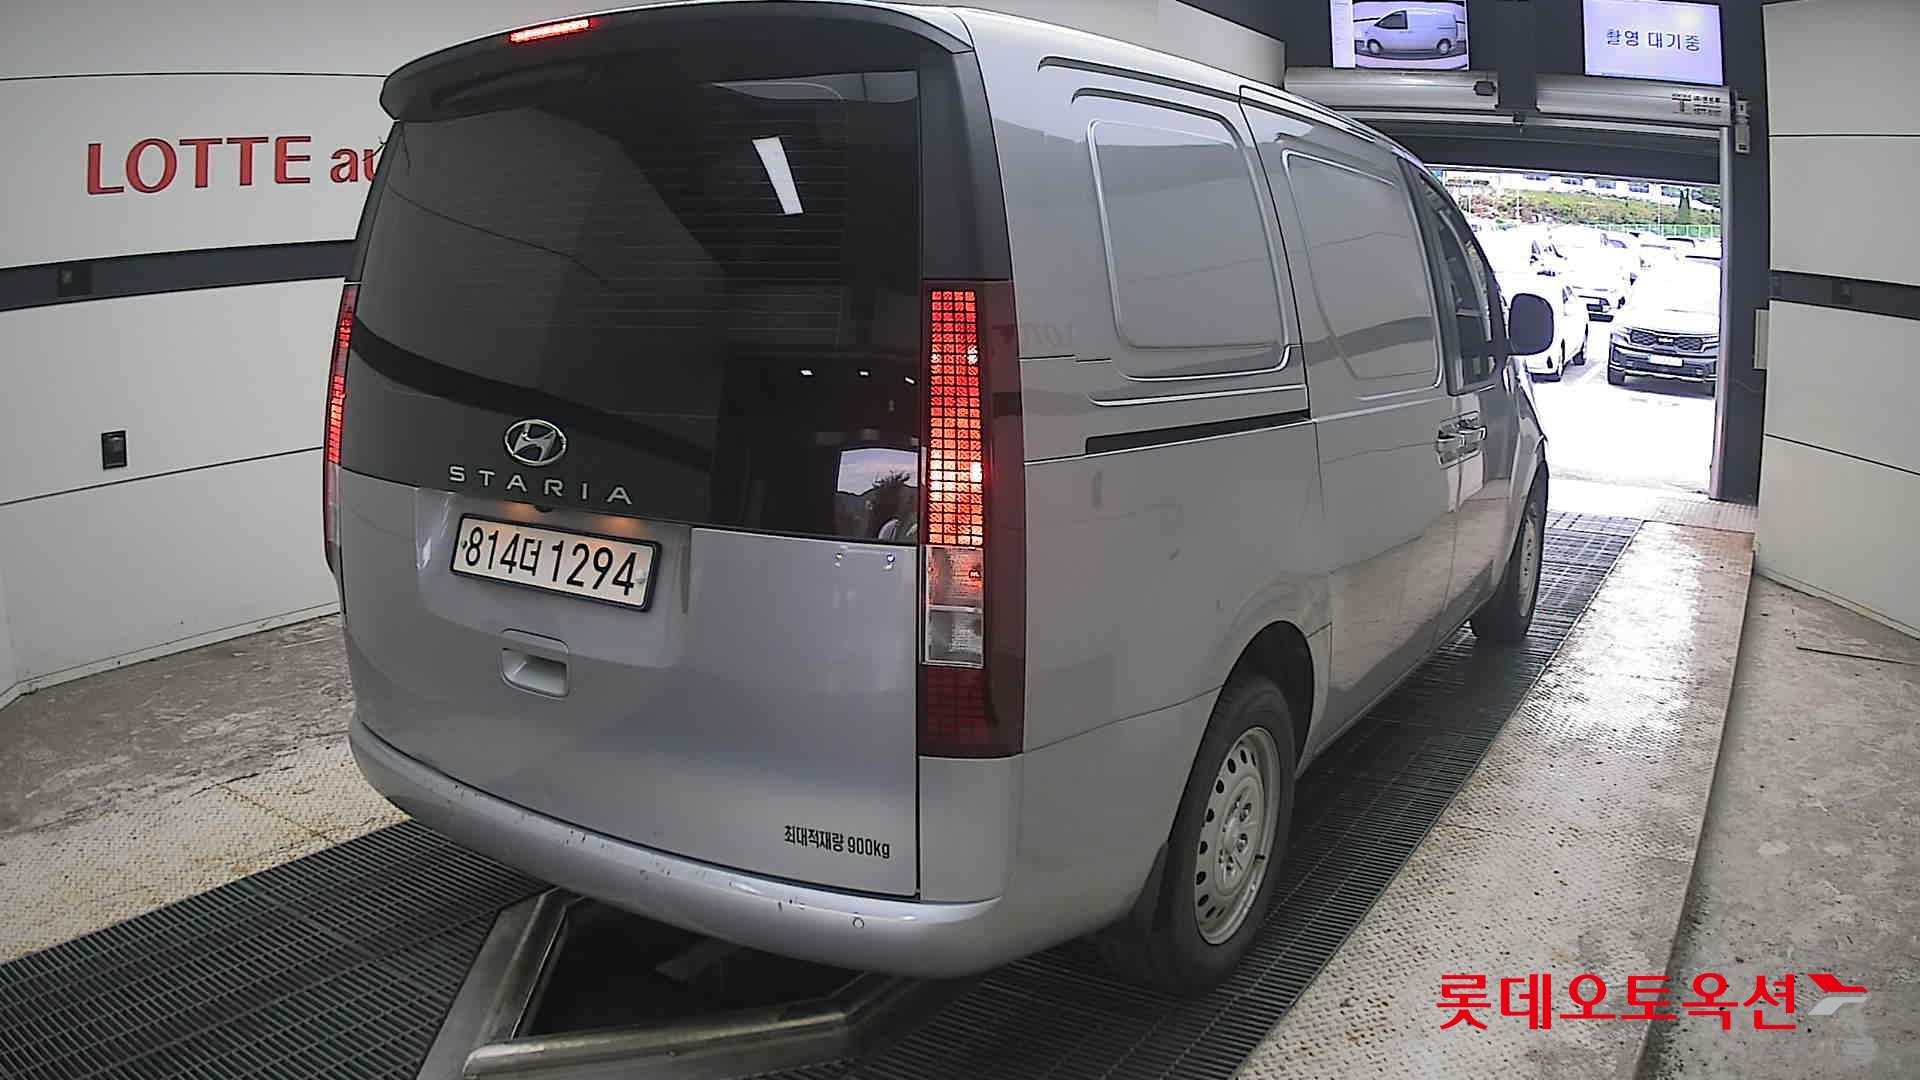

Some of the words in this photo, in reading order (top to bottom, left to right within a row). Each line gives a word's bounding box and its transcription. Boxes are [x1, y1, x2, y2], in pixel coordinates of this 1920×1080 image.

[1648, 31, 1700, 52] 대기중
[86, 135, 312, 195] LOTTE
[449, 465, 632, 505] STARIA
[466, 526, 542, 577] 814더
[552, 539, 637, 596] 1294
[784, 825, 844, 852] 최대적재량
[847, 836, 890, 859] 900kg
